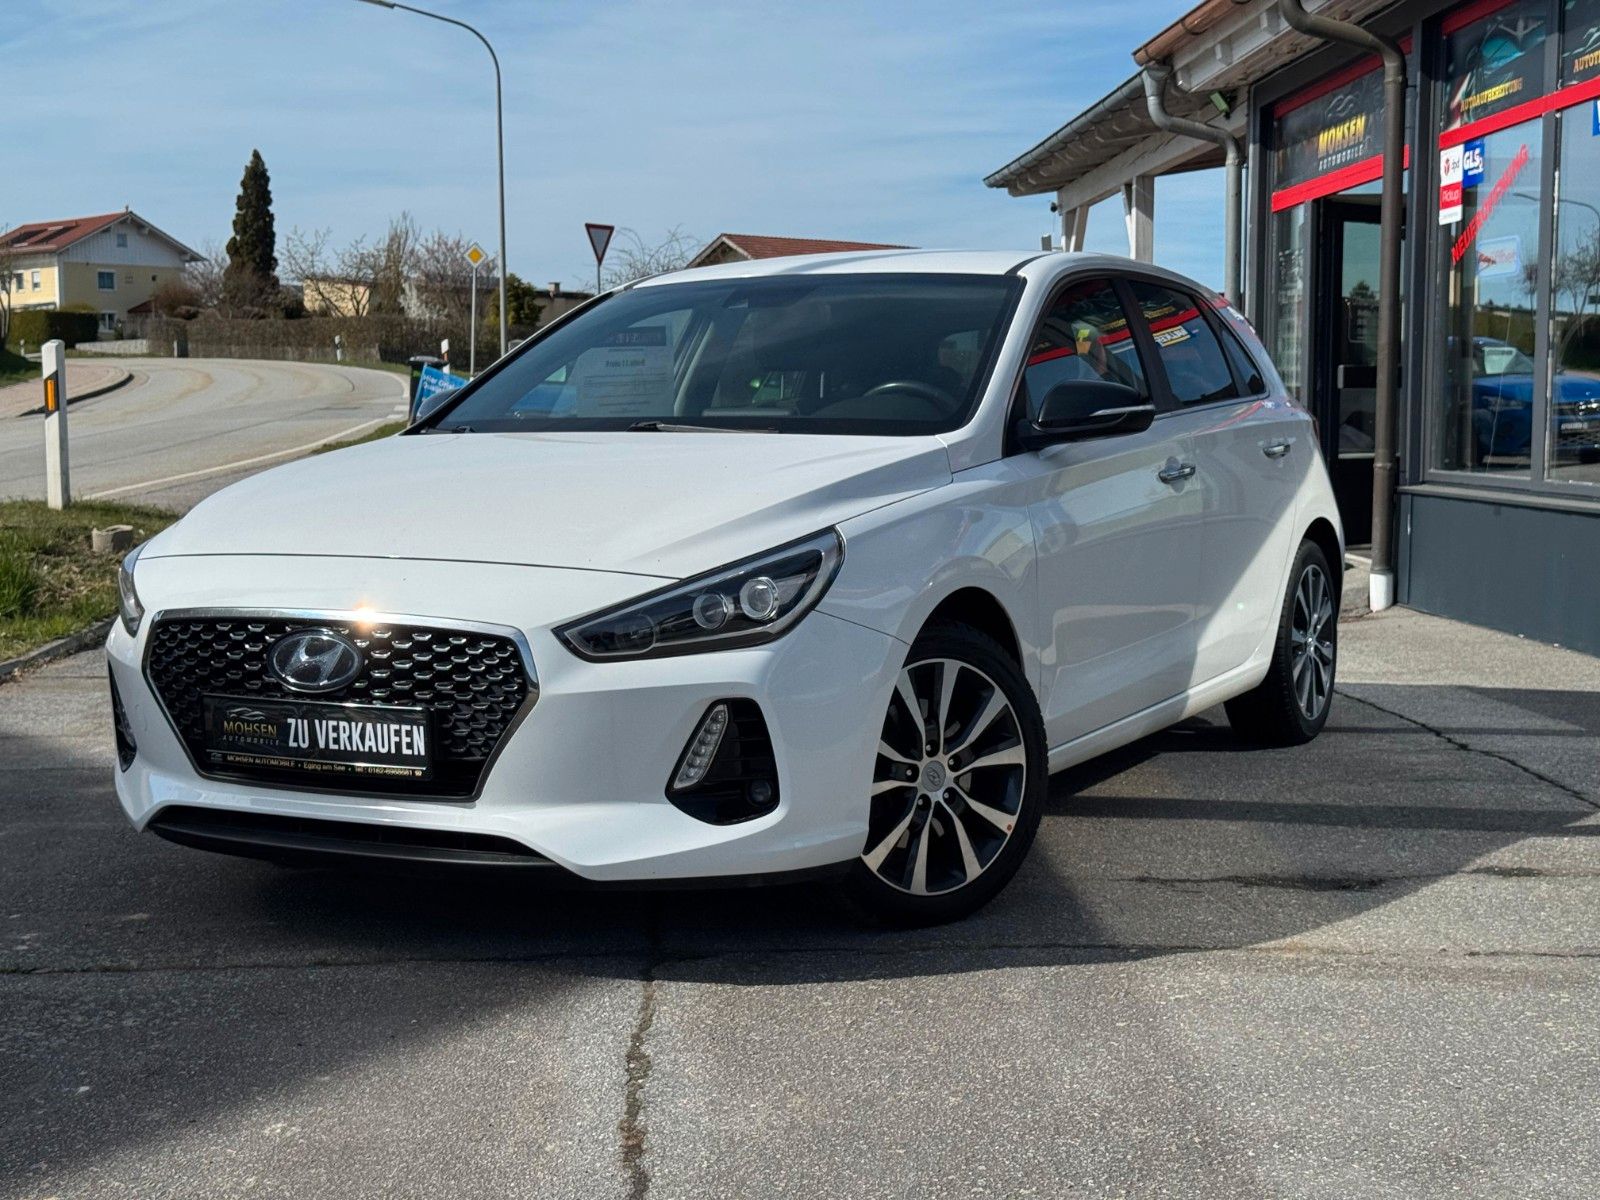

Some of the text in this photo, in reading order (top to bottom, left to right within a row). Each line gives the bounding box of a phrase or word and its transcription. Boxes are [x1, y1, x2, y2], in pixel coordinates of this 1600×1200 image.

[1317, 113, 1366, 159] MOHSEN
[1319, 143, 1364, 171] AUTOMOBILE
[1463, 147, 1481, 171] GLS
[222, 734, 280, 746] AUTOMOBILE
[223, 719, 278, 737] MOHSEN
[286, 718, 426, 756] ZU VERKAUFEN
[333, 763, 346, 772] See
